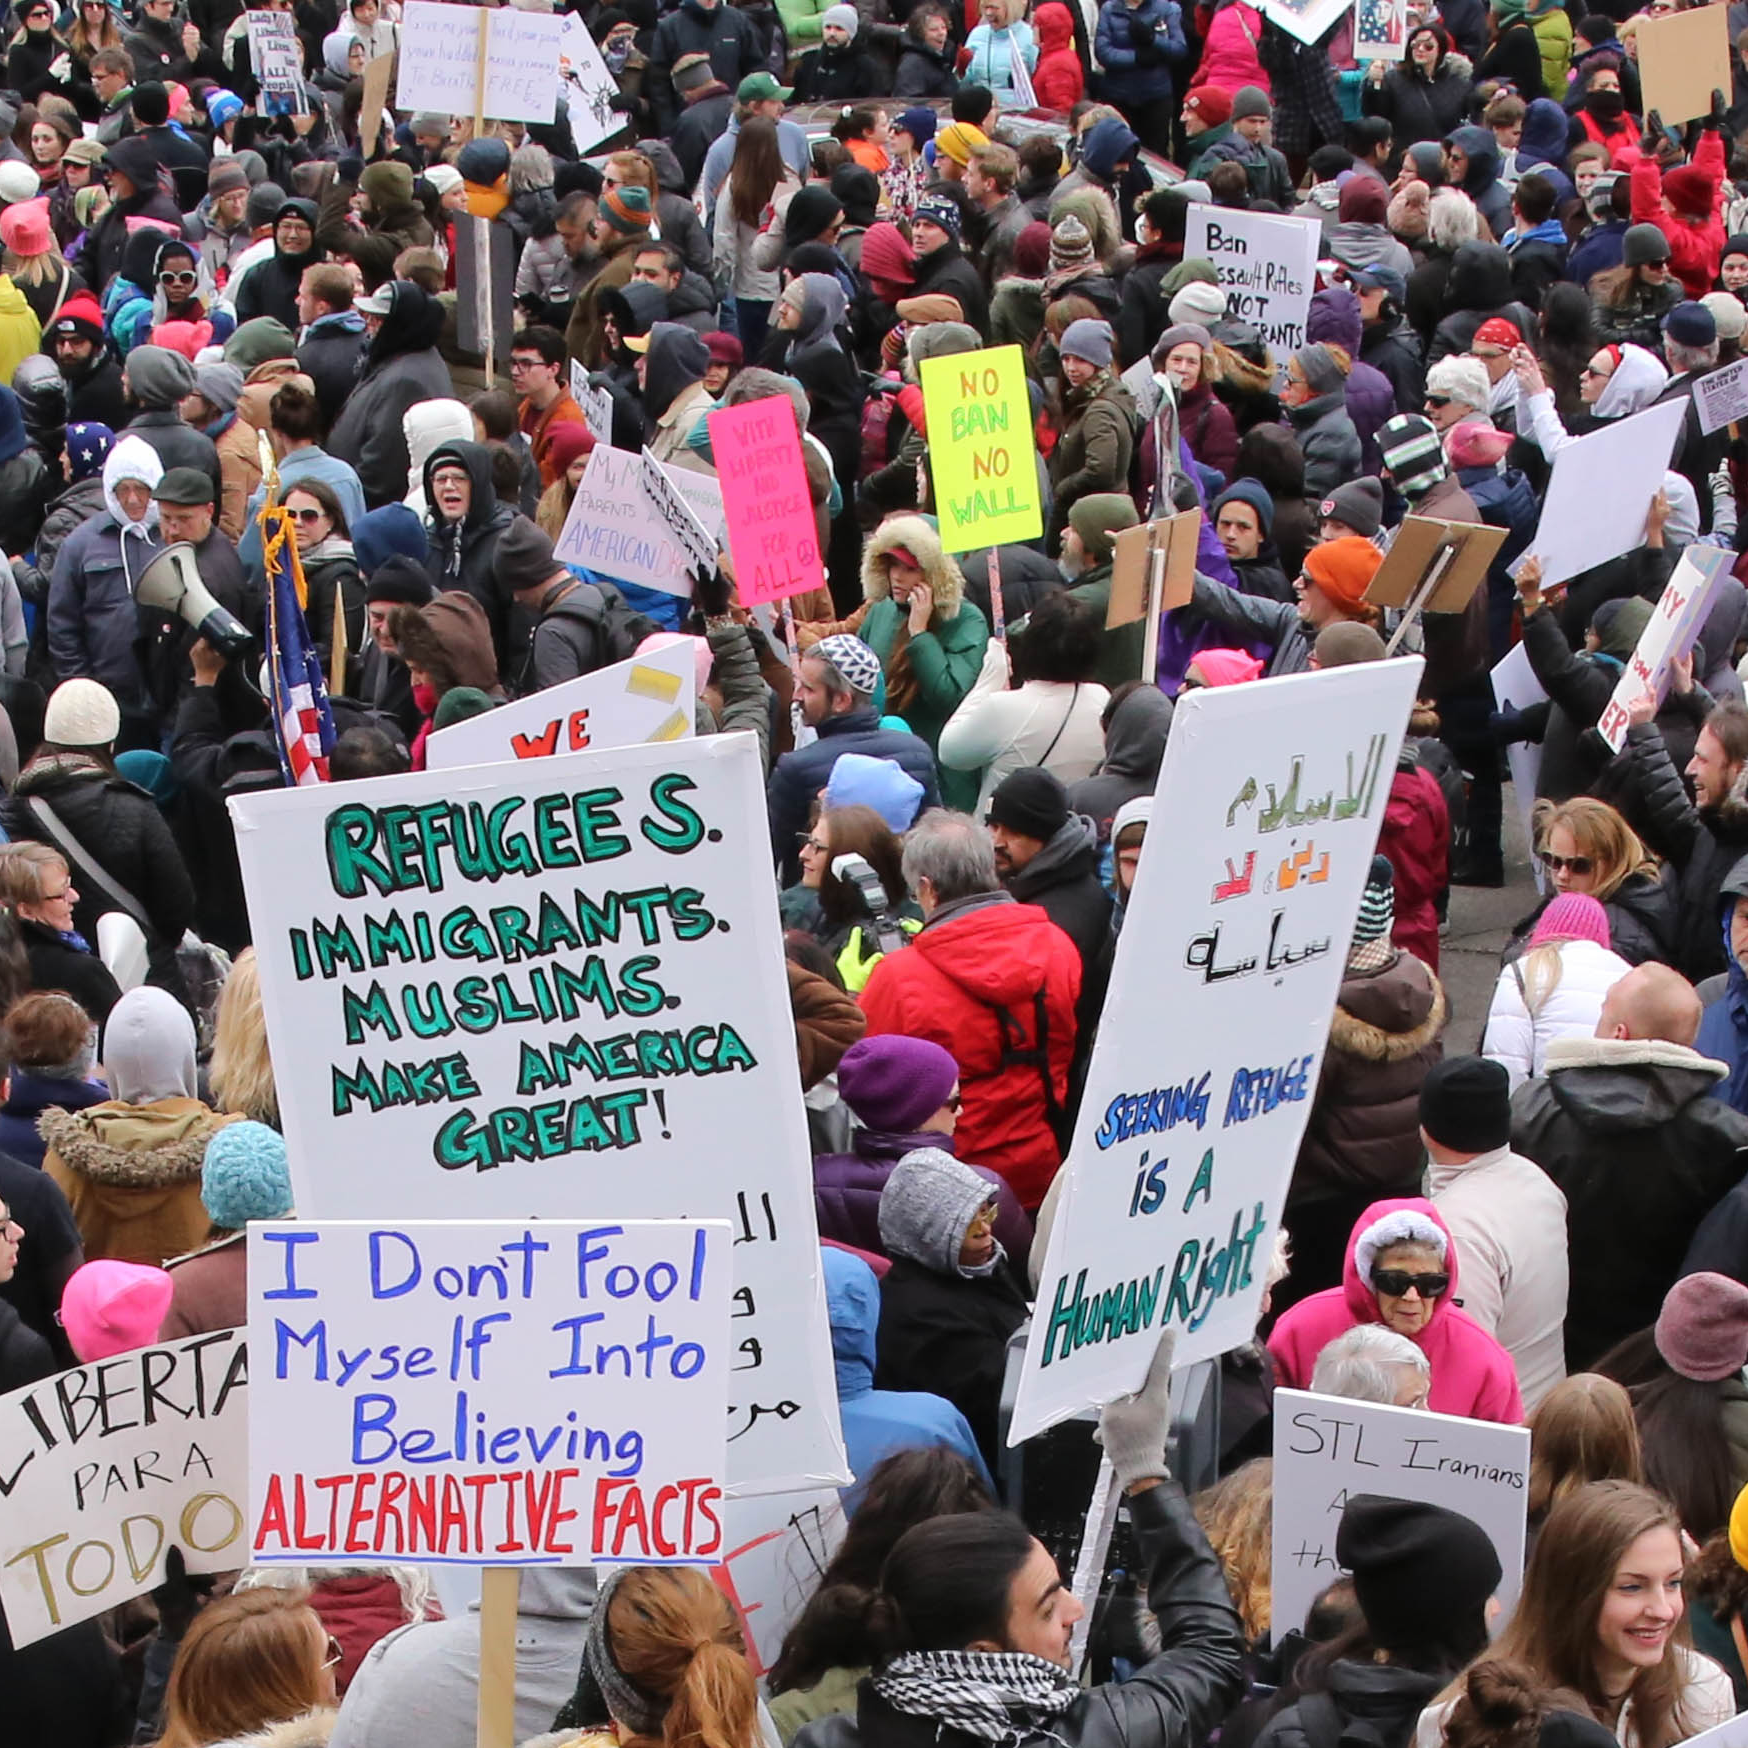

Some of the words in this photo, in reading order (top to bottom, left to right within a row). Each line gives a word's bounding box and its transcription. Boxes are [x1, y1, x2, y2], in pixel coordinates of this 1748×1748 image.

[1206, 222, 1248, 255] Ban
[1210, 258, 1263, 289] ssault
[1265, 261, 1304, 296] Rifles
[1226, 291, 1270, 319] NOT
[958, 368, 999, 401] NO
[733, 415, 775, 449] WITH
[950, 402, 1010, 443] BAN
[592, 452, 620, 488] My
[728, 444, 792, 479] LIBERTY
[971, 449, 1011, 483] NO
[578, 489, 637, 518] PARENTS
[740, 492, 806, 527] JUSTICE
[947, 484, 1032, 529] WALL
[563, 518, 655, 572] AMERICAN
[752, 558, 804, 597] ALL
[510, 708, 591, 760] WE
[289, 884, 732, 981] IMMIGRANTS.
[342, 954, 681, 1045] MUSLIMS.
[330, 1051, 483, 1117] MAKE
[517, 1022, 759, 1095] AMERICA
[1094, 1069, 1212, 1152] SEEKING
[1223, 1053, 1314, 1131] REFUGE
[433, 1088, 673, 1172] GREAT!
[1182, 1146, 1213, 1213] A
[262, 1229, 320, 1299] I
[368, 1229, 550, 1301] Don't
[576, 1225, 707, 1301] Fool
[273, 1311, 512, 1387] Myself
[550, 1311, 706, 1379] Into
[351, 1391, 645, 1478] Believing
[1290, 1411, 1380, 1470] STL
[1403, 1437, 1525, 1491] Iranians
[72, 1440, 215, 1512] PARA
[254, 1468, 580, 1556] ALTERNATIVE
[590, 1477, 723, 1555] FACTS
[4, 1489, 245, 1628] TODO
